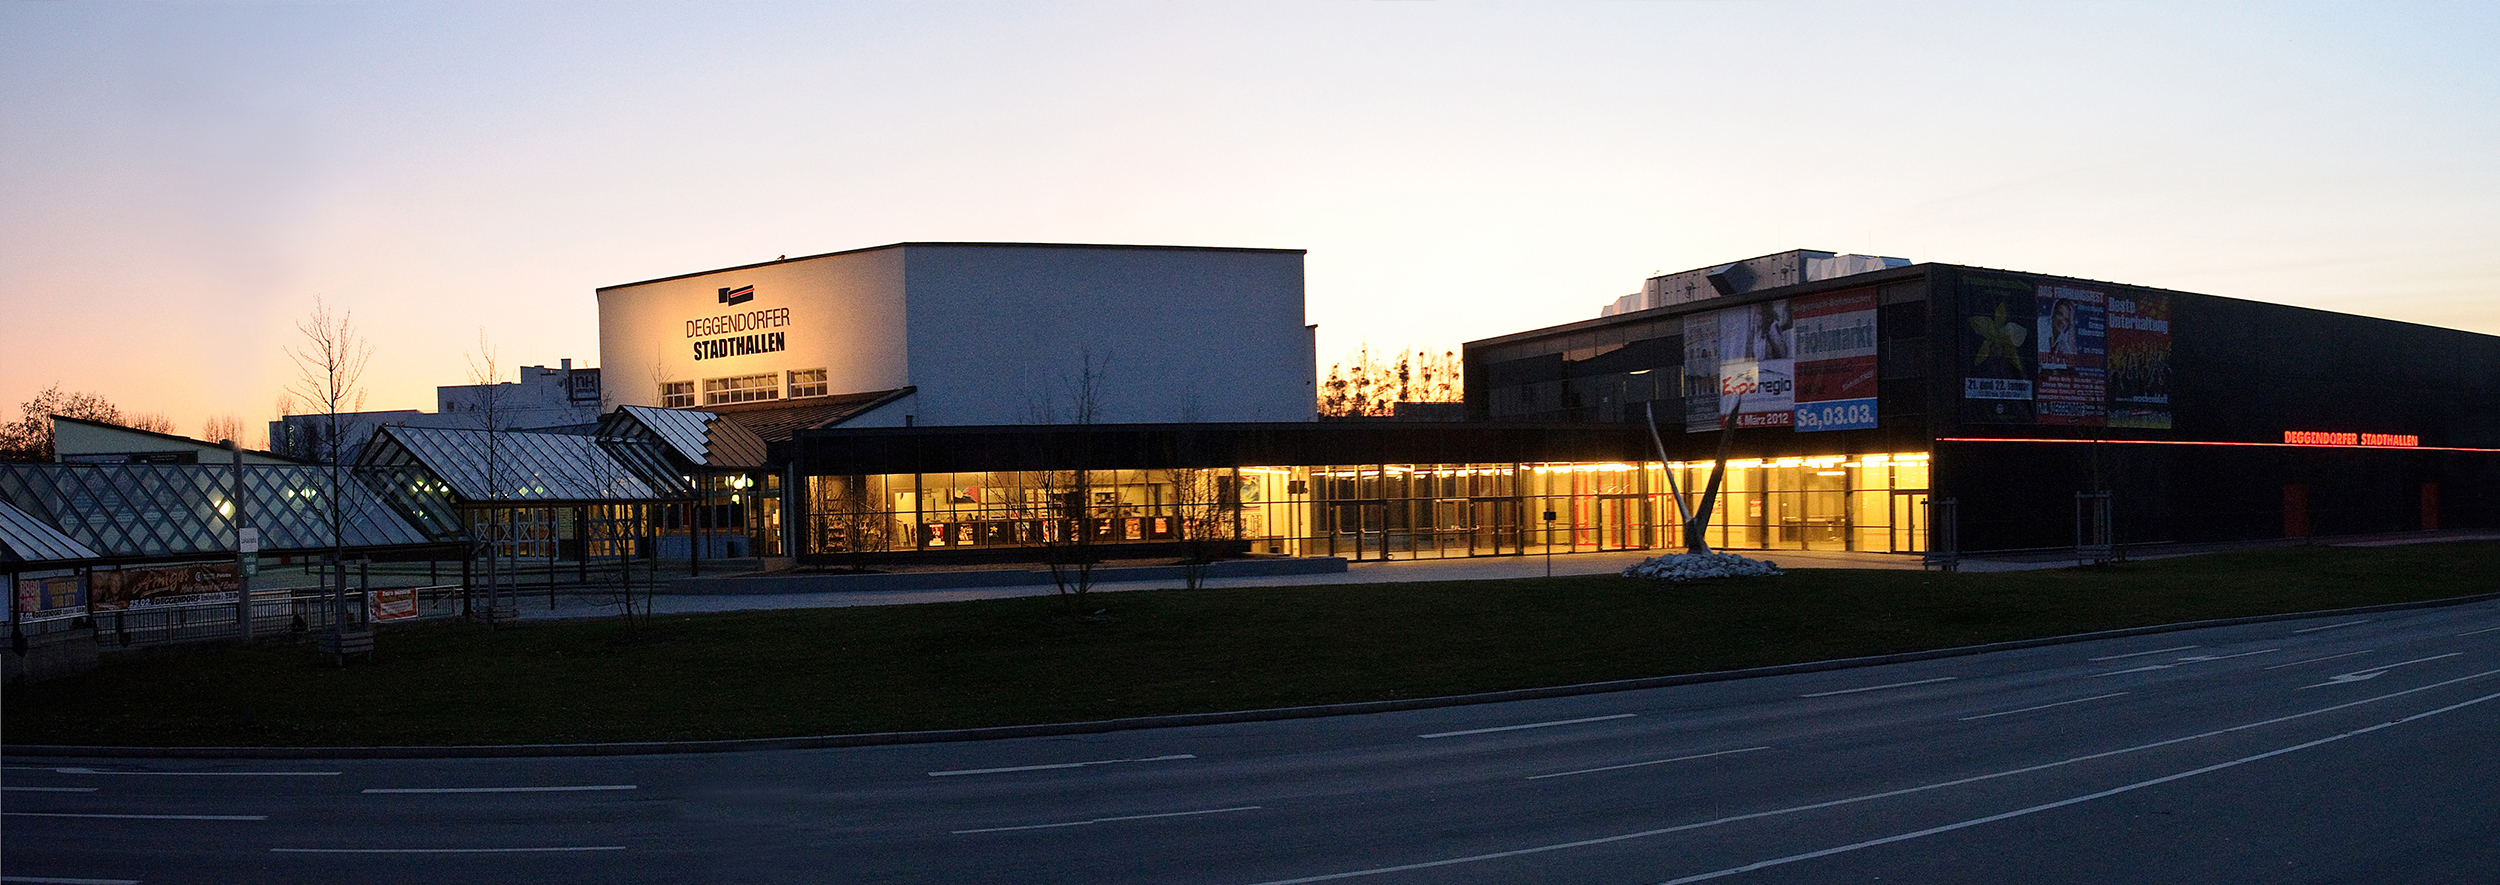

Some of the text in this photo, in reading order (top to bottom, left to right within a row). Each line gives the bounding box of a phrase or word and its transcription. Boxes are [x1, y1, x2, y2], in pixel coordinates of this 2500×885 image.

[2108, 297, 2136, 314] Beste
[686, 307, 790, 338] DEGGENDORFER
[2108, 313, 2169, 335] Unterhaltung
[694, 332, 785, 361] STADTHALLEN
[1796, 317, 1874, 354] Flohmarkt
[1744, 414, 1766, 426] März
[1766, 412, 1789, 424] 2012
[2284, 430, 2419, 446] DEGGENDORFER STADTHALLEN
[132, 567, 190, 596] Amigos
[155, 594, 201, 606] DEGGENDORF
